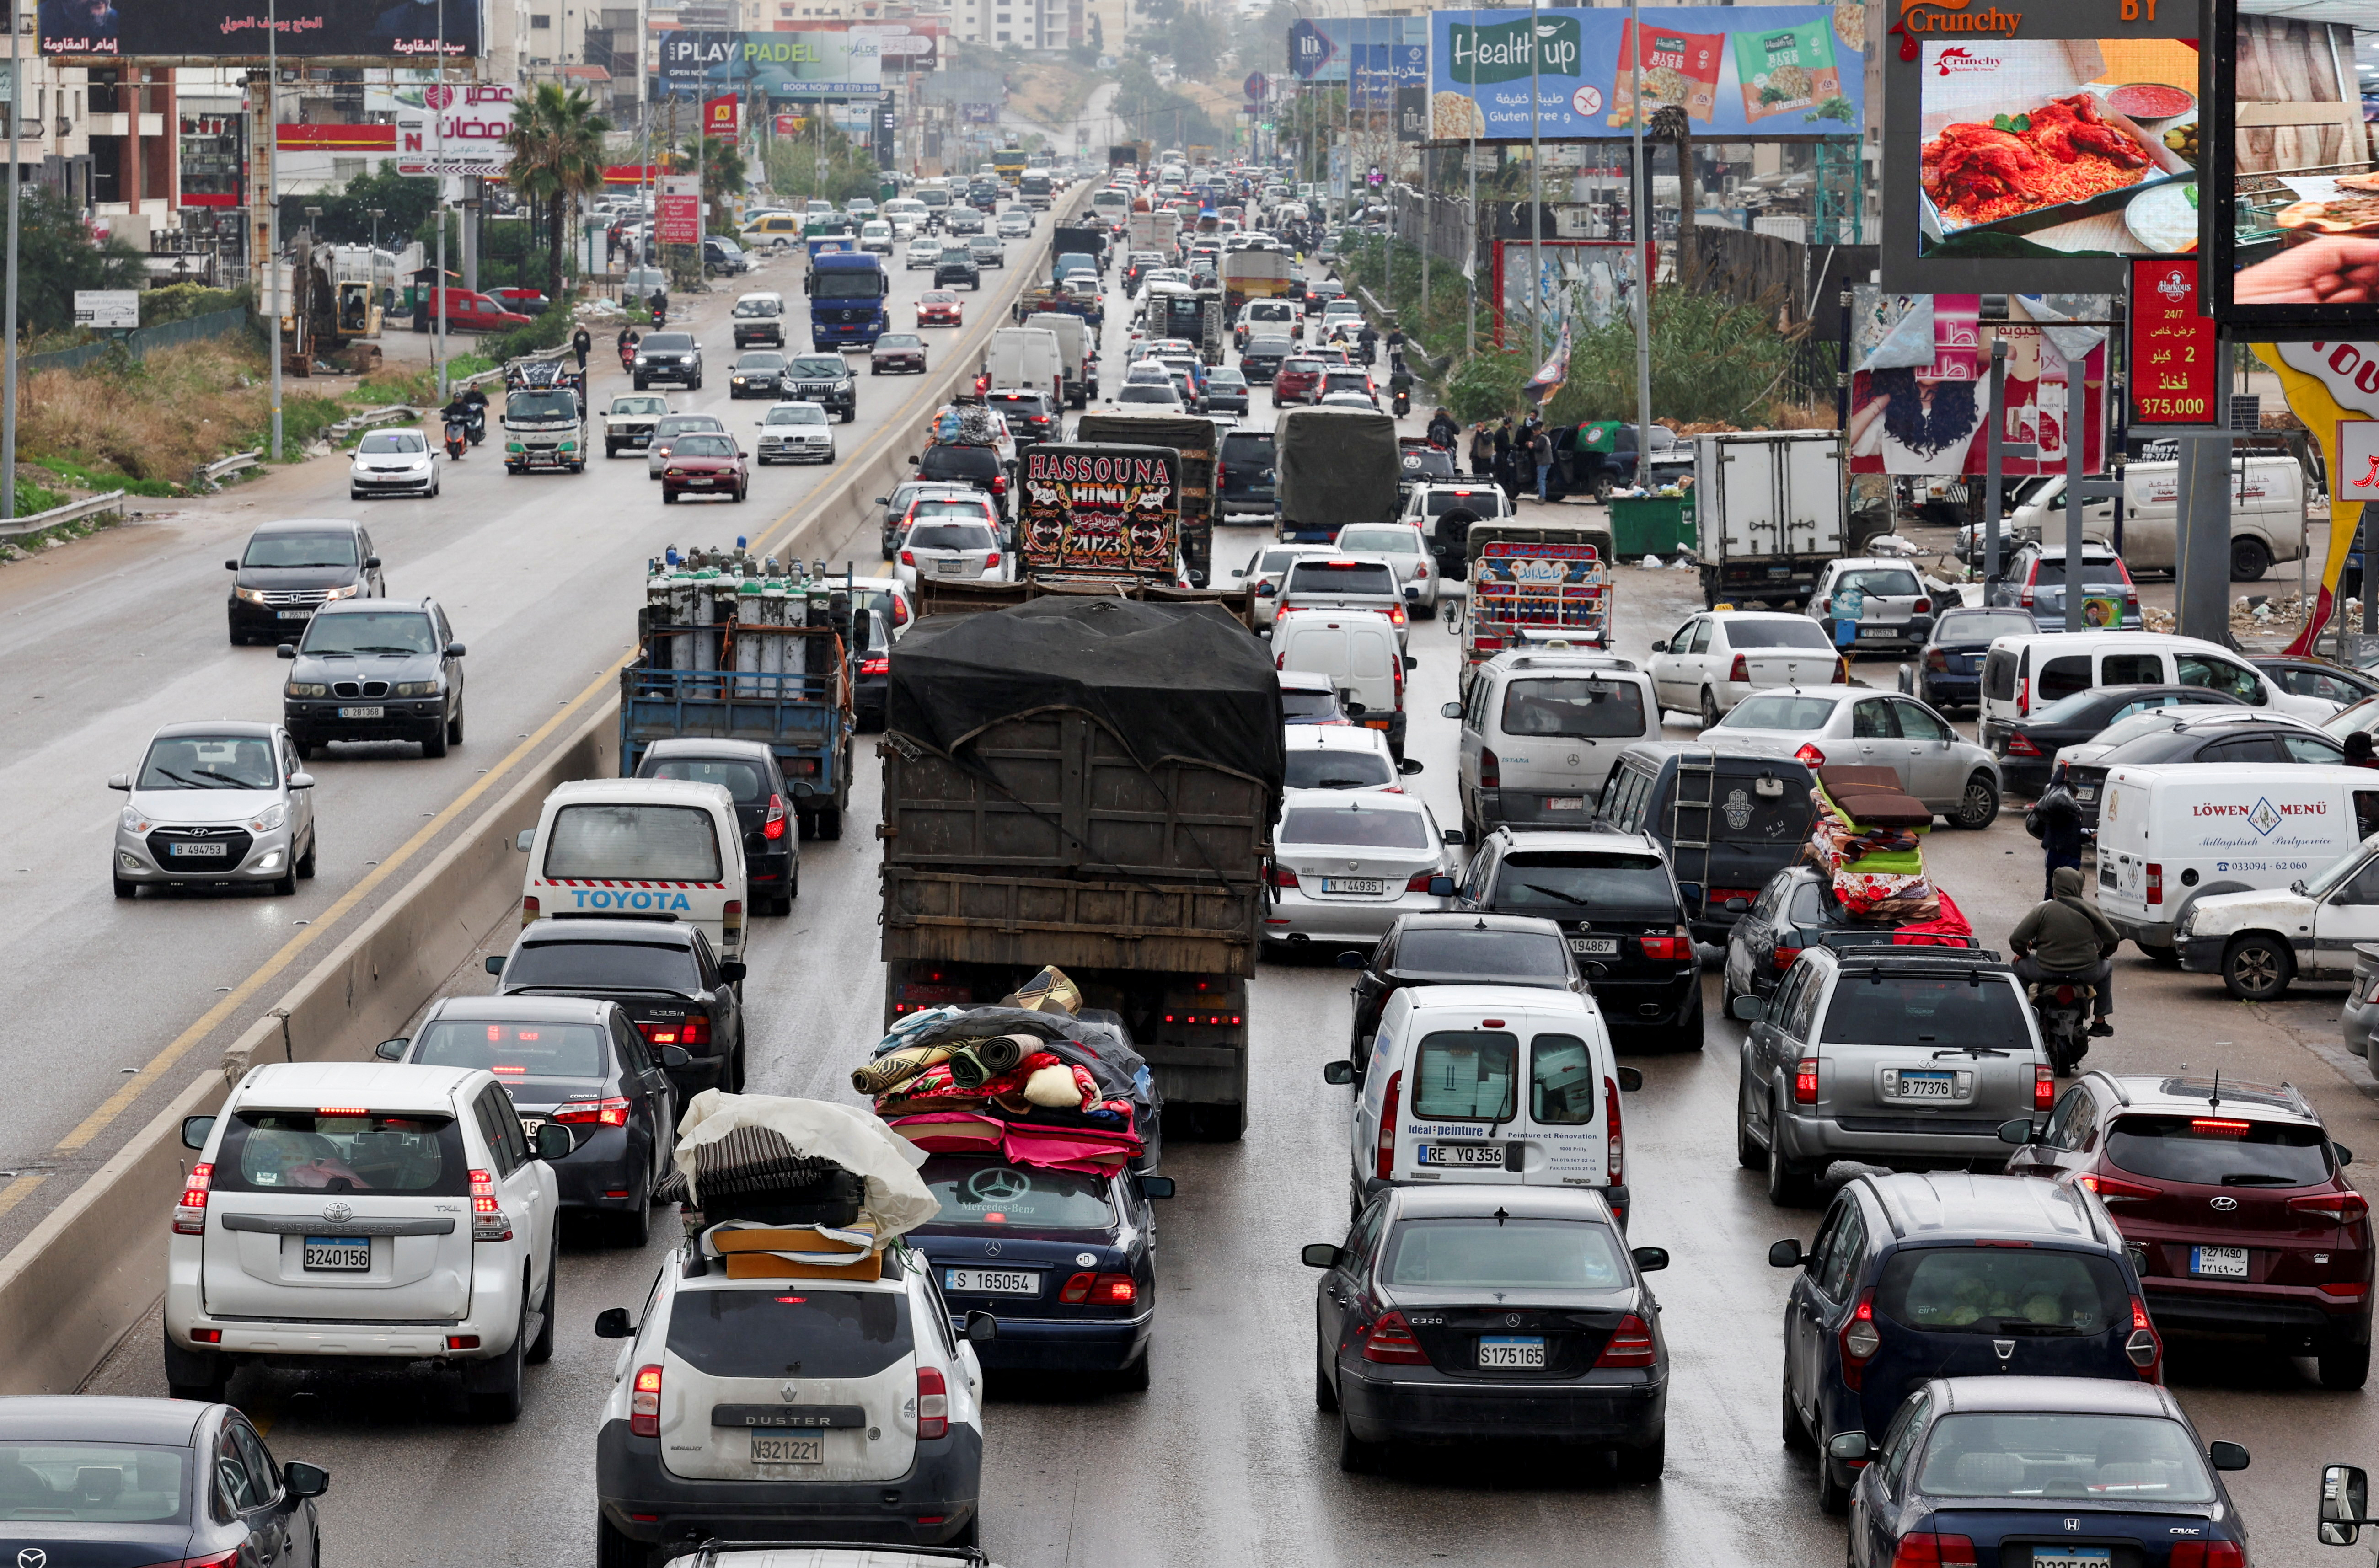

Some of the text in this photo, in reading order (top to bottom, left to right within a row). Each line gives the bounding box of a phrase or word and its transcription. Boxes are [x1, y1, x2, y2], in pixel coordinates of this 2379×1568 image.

[2120, 0, 2157, 21] BY
[293, 17, 324, 33] الحاج
[1907, 10, 2022, 38] Crunchy
[43, 38, 118, 54] إمام المقاومة
[393, 39, 466, 55] سيد المقاومة
[1656, 37, 1677, 49] Health
[1765, 38, 1785, 49] Health
[678, 43, 737, 61] PLAY
[744, 43, 820, 62] PADEL
[1454, 32, 1575, 73] Health up
[1653, 51, 1684, 61] RICE
[1768, 51, 1798, 63] RICE
[1651, 59, 1683, 69] CORN
[1769, 58, 1799, 70] CORN
[1942, 58, 2003, 71] Crunchy
[782, 83, 808, 91] BOOK
[863, 84, 877, 92] 940
[465, 87, 513, 106] عصير
[1496, 93, 1529, 106] خفيفة
[1775, 97, 1811, 111] HERBS
[1489, 111, 1529, 122] Gluten
[2157, 280, 2191, 293] Harkous
[2164, 309, 2184, 319] 24/7
[2150, 326, 2197, 337] عرض خاص
[2149, 346, 2195, 364] 2 كيلو
[2159, 372, 2188, 390] فخاذ
[2141, 399, 2204, 417] 375,000
[1027, 454, 1170, 484] HASSOUNA
[1072, 482, 1126, 508] HINO
[1072, 531, 1121, 557] 2023
[1486, 596, 1591, 626] TOYOTA
[353, 708, 379, 717] 281368
[1554, 800, 1558, 808] P
[2193, 801, 2327, 817] LÖWEN MENÜ
[2198, 835, 2333, 850] Mittagstisch Partyservice
[177, 845, 221, 855] B 494753
[2232, 862, 2266, 872] 033094
[2275, 862, 2288, 870] 62
[2289, 862, 2308, 870] 060
[1342, 883, 1377, 892] 144935
[571, 890, 691, 910] TOYOTA
[1573, 940, 1610, 952] 194867
[1902, 1081, 1949, 1095] B 77376
[1409, 1124, 1484, 1137] Idéal peinture
[1555, 1131, 1597, 1140] Rénovation
[1428, 1148, 1447, 1162] RE
[1456, 1148, 1474, 1163] YQ
[1476, 1148, 1502, 1163] 356
[962, 1202, 1035, 1214] Mercedes-Benz
[306, 1223, 359, 1231] CRUISER
[306, 1249, 368, 1266] B240156
[1083, 1255, 1089, 1264] D
[2207, 1249, 2242, 1262] 271490
[957, 1273, 1029, 1290] S 165054
[1481, 1348, 1543, 1365] S175165
[904, 1397, 916, 1412] 4
[745, 1416, 831, 1426] DUSTER
[752, 1440, 819, 1460] N321221
[2169, 1527, 2200, 1536] CIVIC
